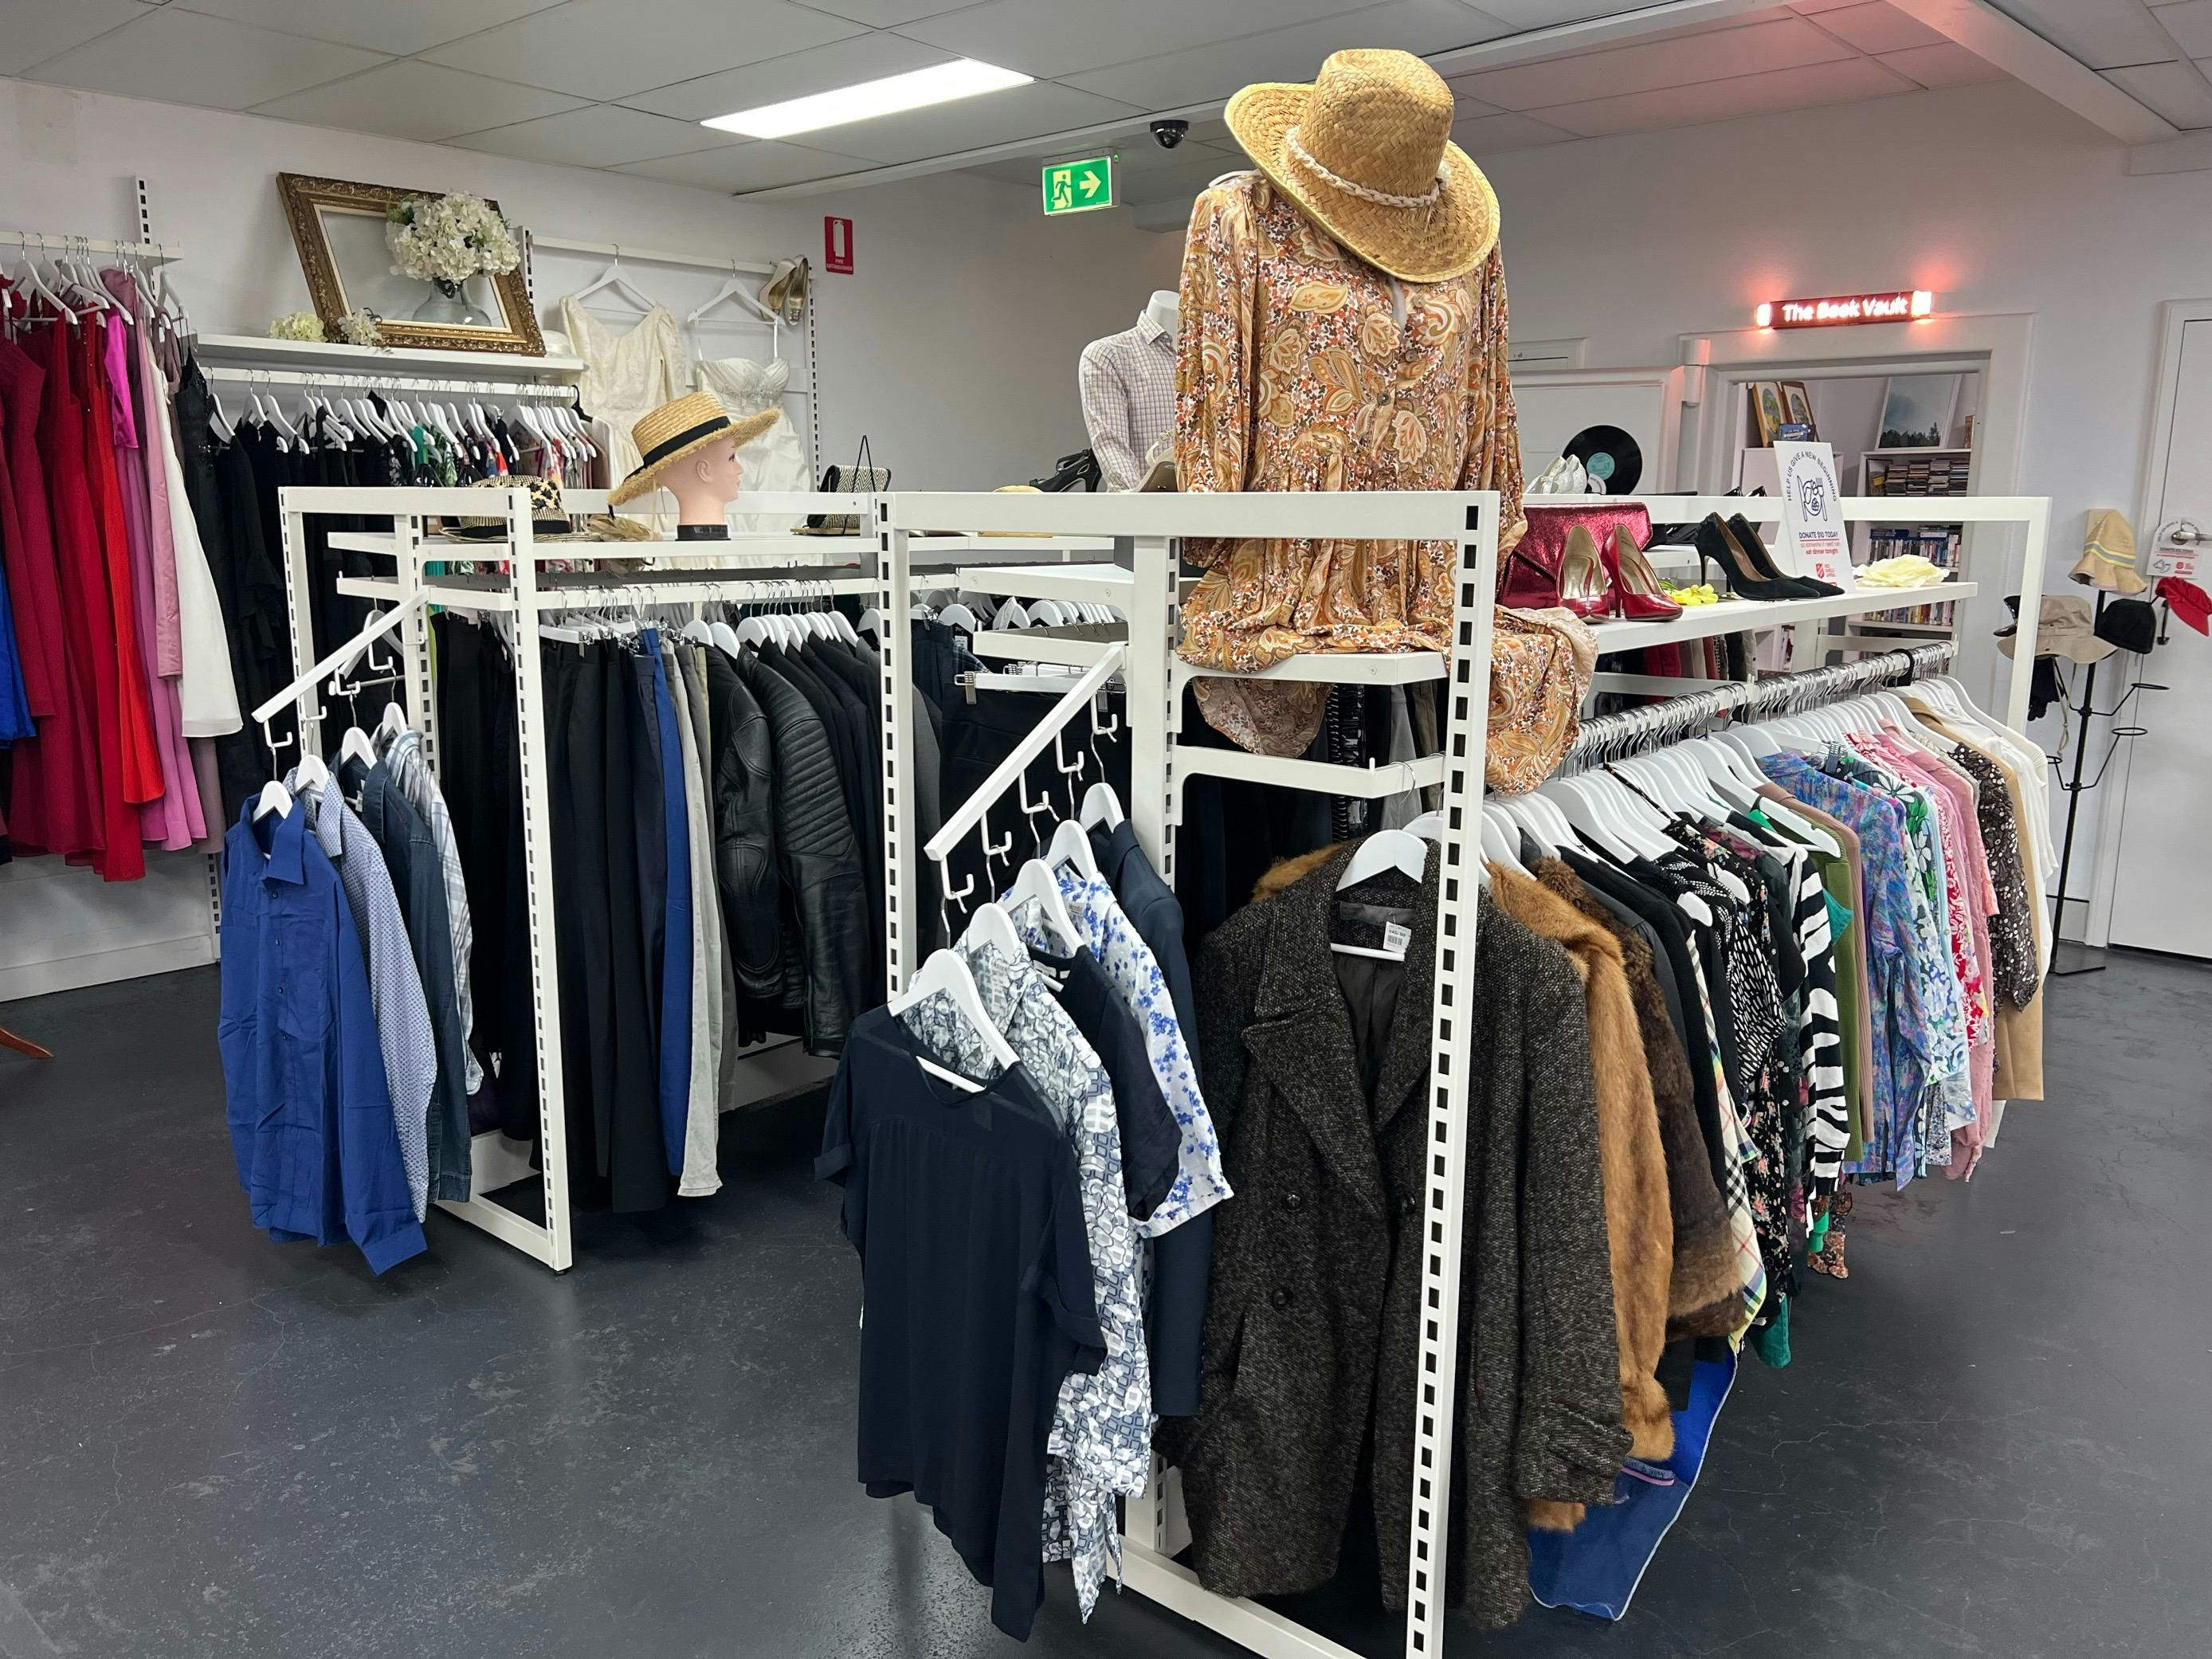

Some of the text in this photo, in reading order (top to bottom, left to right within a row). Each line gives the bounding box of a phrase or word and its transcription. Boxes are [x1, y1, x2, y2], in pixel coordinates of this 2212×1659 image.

[1782, 296, 1908, 322] The Book Vault
[1787, 466, 1793, 478] US
[1790, 453, 1802, 467] GIVE
[1805, 451, 1817, 461] NEW
[1817, 457, 1837, 502] BEGINNING
